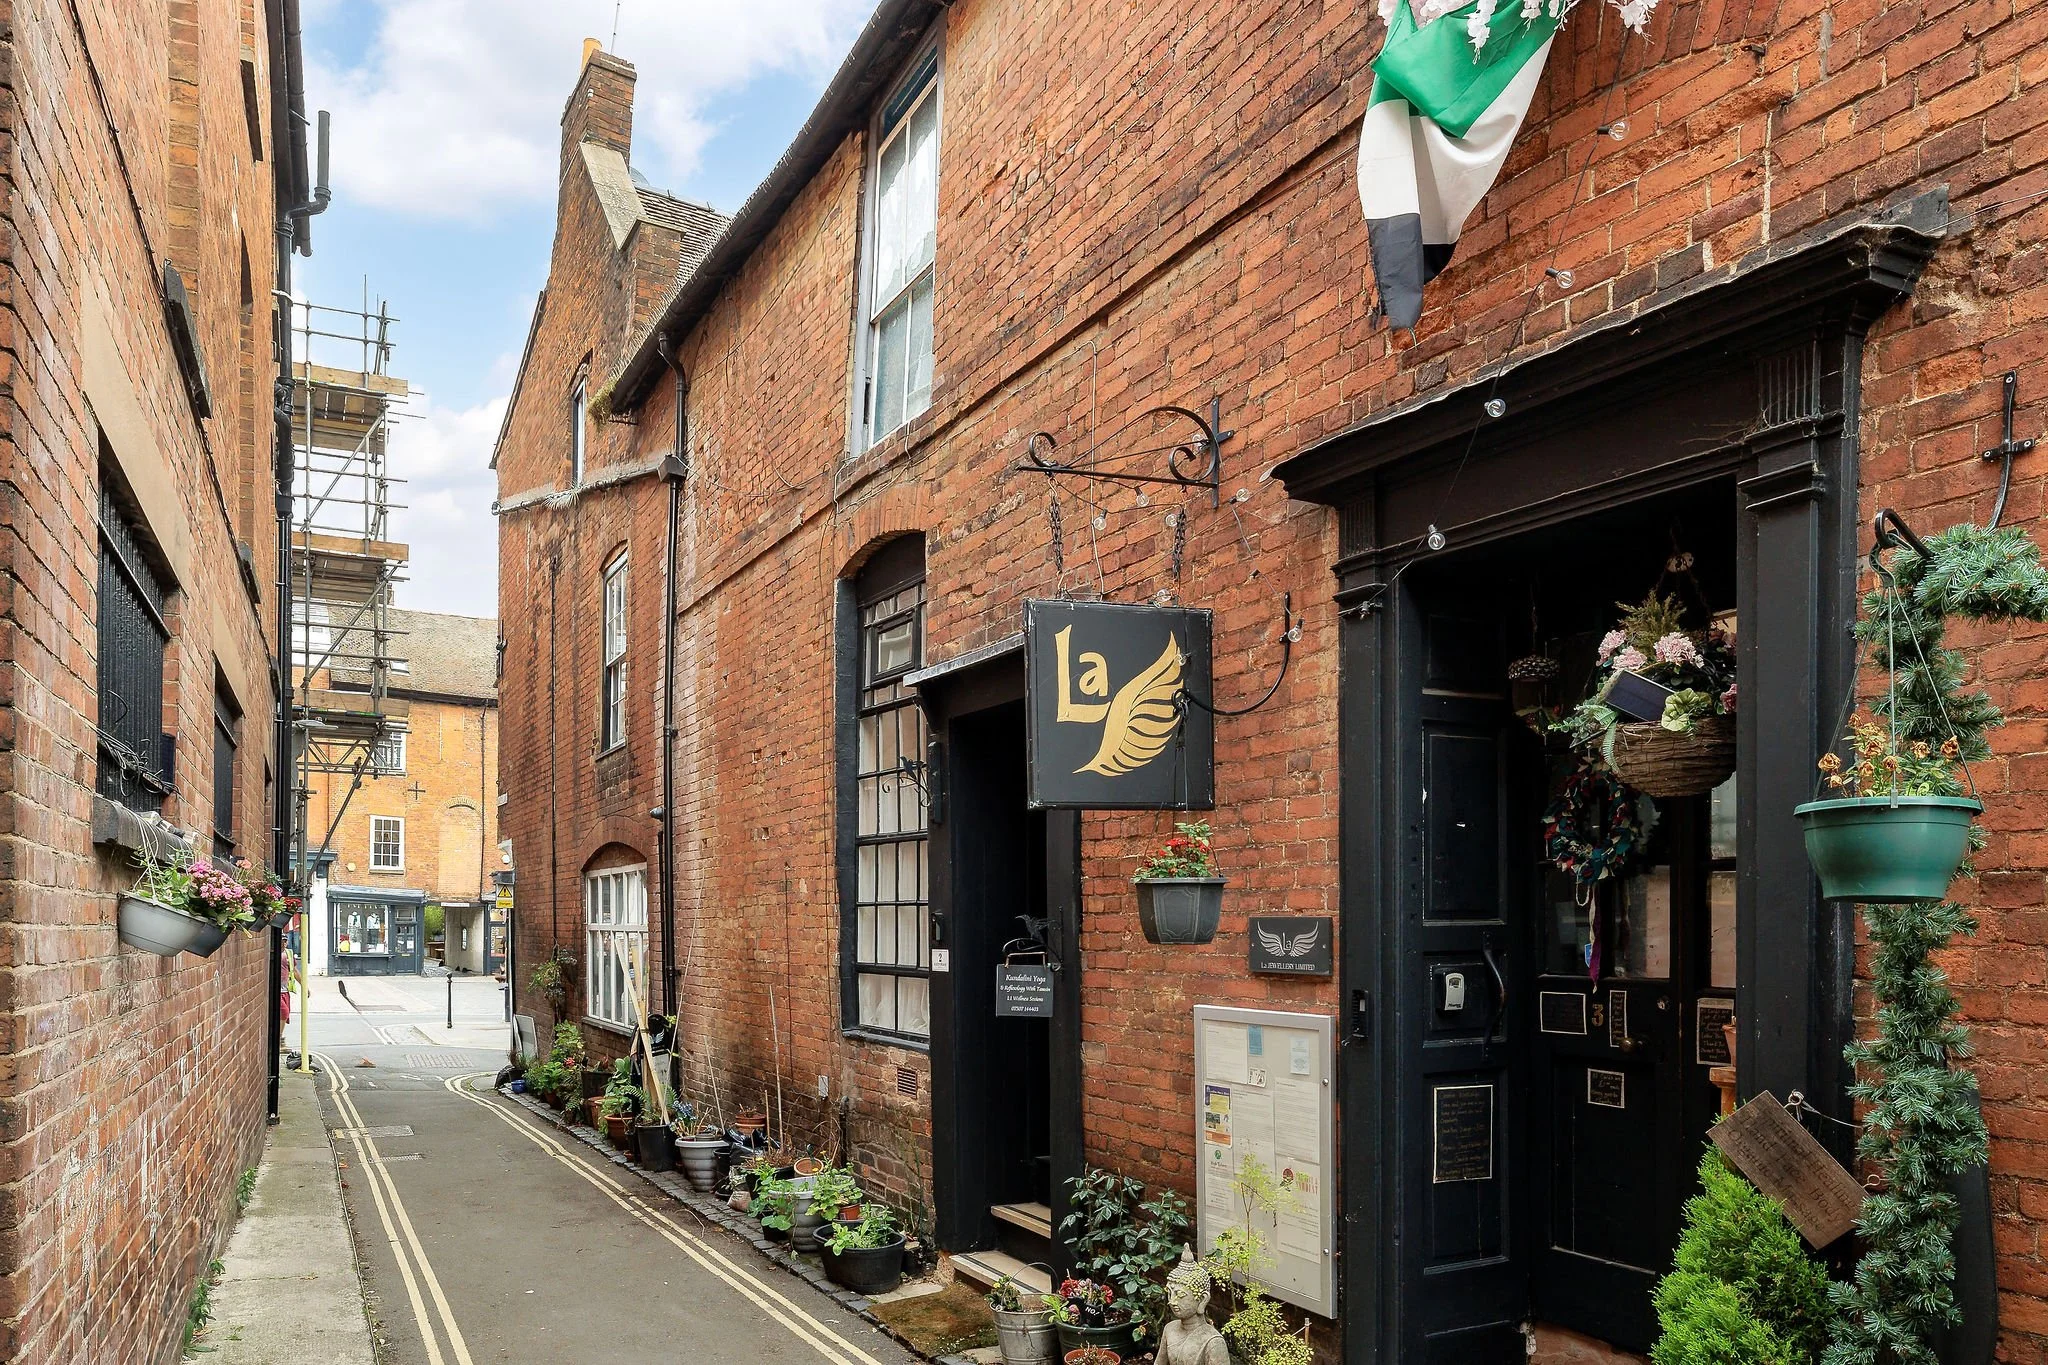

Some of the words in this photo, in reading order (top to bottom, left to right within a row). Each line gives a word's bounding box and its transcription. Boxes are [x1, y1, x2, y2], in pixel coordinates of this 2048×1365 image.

[1054, 624, 1110, 722] La
[1282, 932, 1292, 950] La
[1004, 985, 1025, 993] Reflexology
[1033, 975, 1046, 984] Yoga
[1592, 1003, 1604, 1027] 3
[1727, 1128, 1773, 1178] Organic
[1809, 1160, 1857, 1208] Healing
[1808, 1187, 1842, 1224] Body
[1085, 1306, 1100, 1316] NO!
